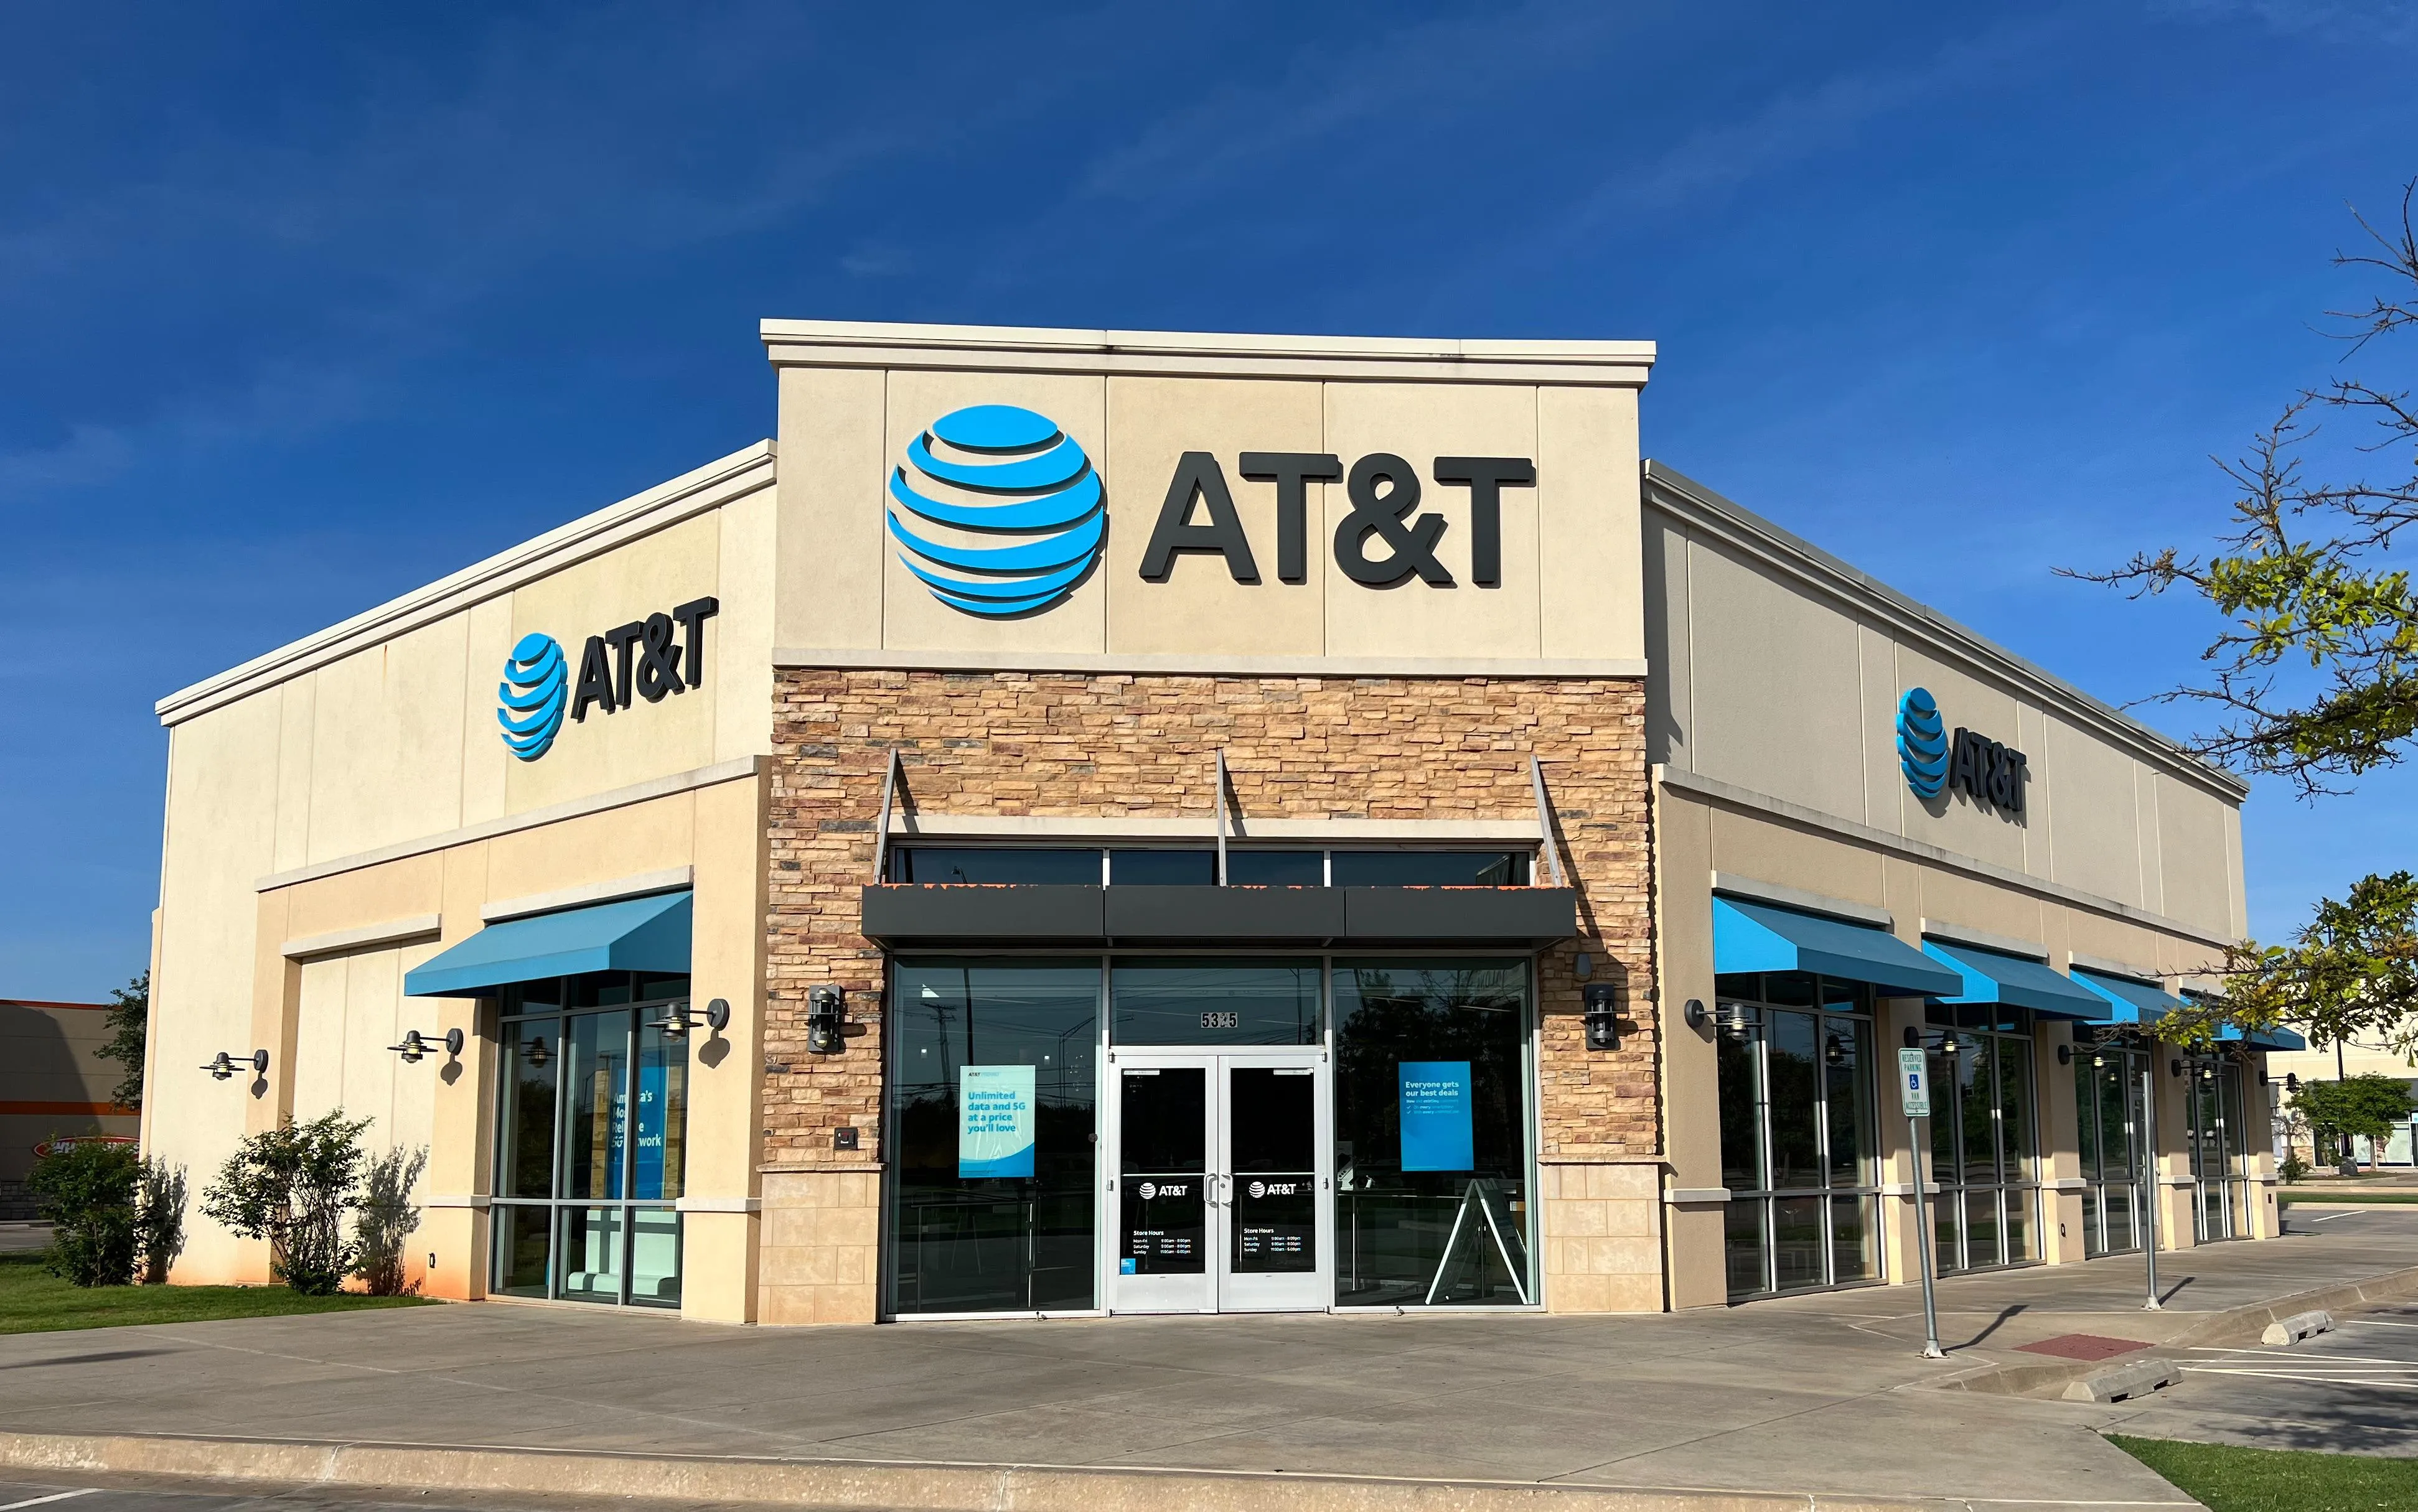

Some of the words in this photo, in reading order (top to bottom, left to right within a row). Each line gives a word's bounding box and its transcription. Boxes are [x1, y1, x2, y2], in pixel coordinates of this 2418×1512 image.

[1139, 451, 1533, 585] AT&T
[571, 596, 719, 723] AT&T
[1949, 727, 2027, 812] AT&T
[1405, 1081, 1441, 1090] Everyone
[1442, 1081, 1460, 1089] gets
[613, 1090, 652, 1104] Ama's
[968, 1091, 1016, 1100] Unlimited
[968, 1103, 990, 1111] data
[993, 1102, 1011, 1111] and
[1013, 1102, 1026, 1110] 5G
[988, 1113, 1013, 1123] price
[612, 1120, 644, 1132] Rele
[968, 1124, 994, 1134] you'll
[996, 1124, 1016, 1132] love
[638, 1134, 662, 1147] work
[1159, 1185, 1188, 1196] AT&T
[1267, 1183, 1296, 1195] AT&T
